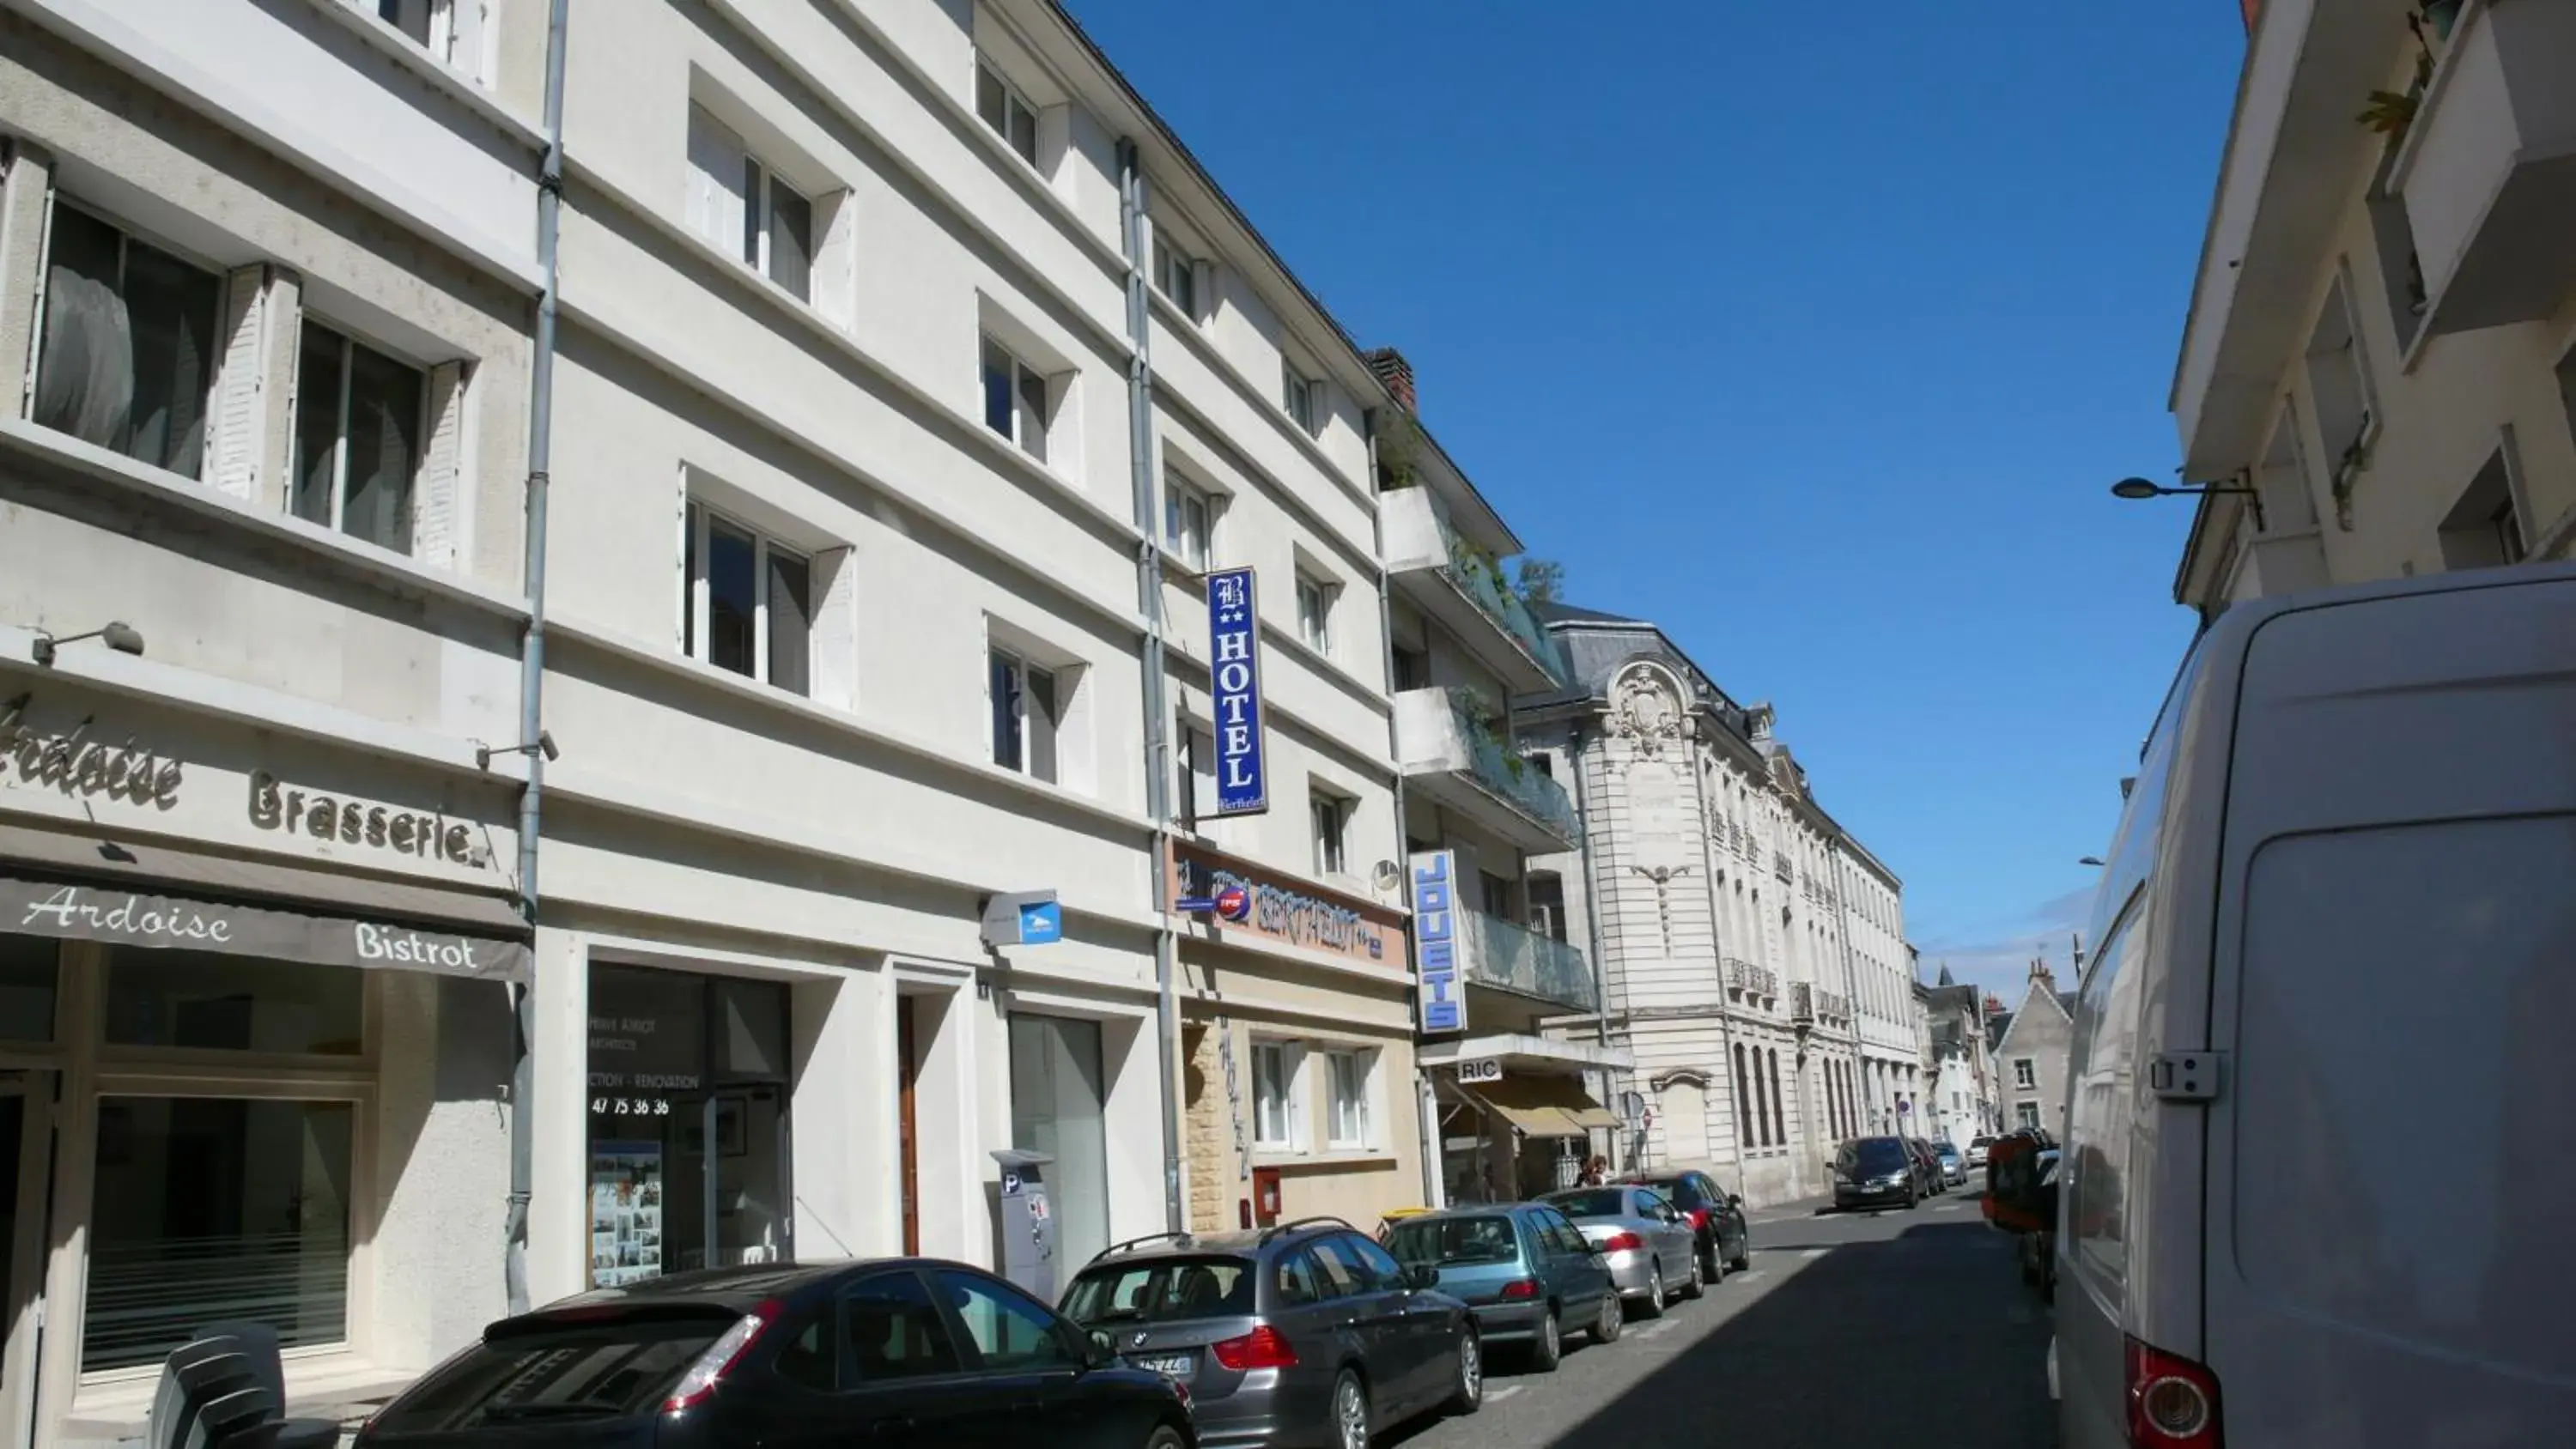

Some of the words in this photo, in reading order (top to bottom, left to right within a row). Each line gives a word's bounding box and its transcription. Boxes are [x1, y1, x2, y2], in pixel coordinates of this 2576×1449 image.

[1218, 631, 1253, 788] HOTEL
[248, 768, 471, 864] Brasserie
[21, 887, 233, 943] Ardoise
[355, 922, 477, 968] Bistrot
[1415, 853, 1457, 1029] JOUETS
[592, 1097, 609, 1115] 47
[613, 1097, 629, 1115] 75
[633, 1098, 649, 1115] 36
[1462, 1060, 1497, 1078] RIC
[1005, 1173, 1018, 1193] P
